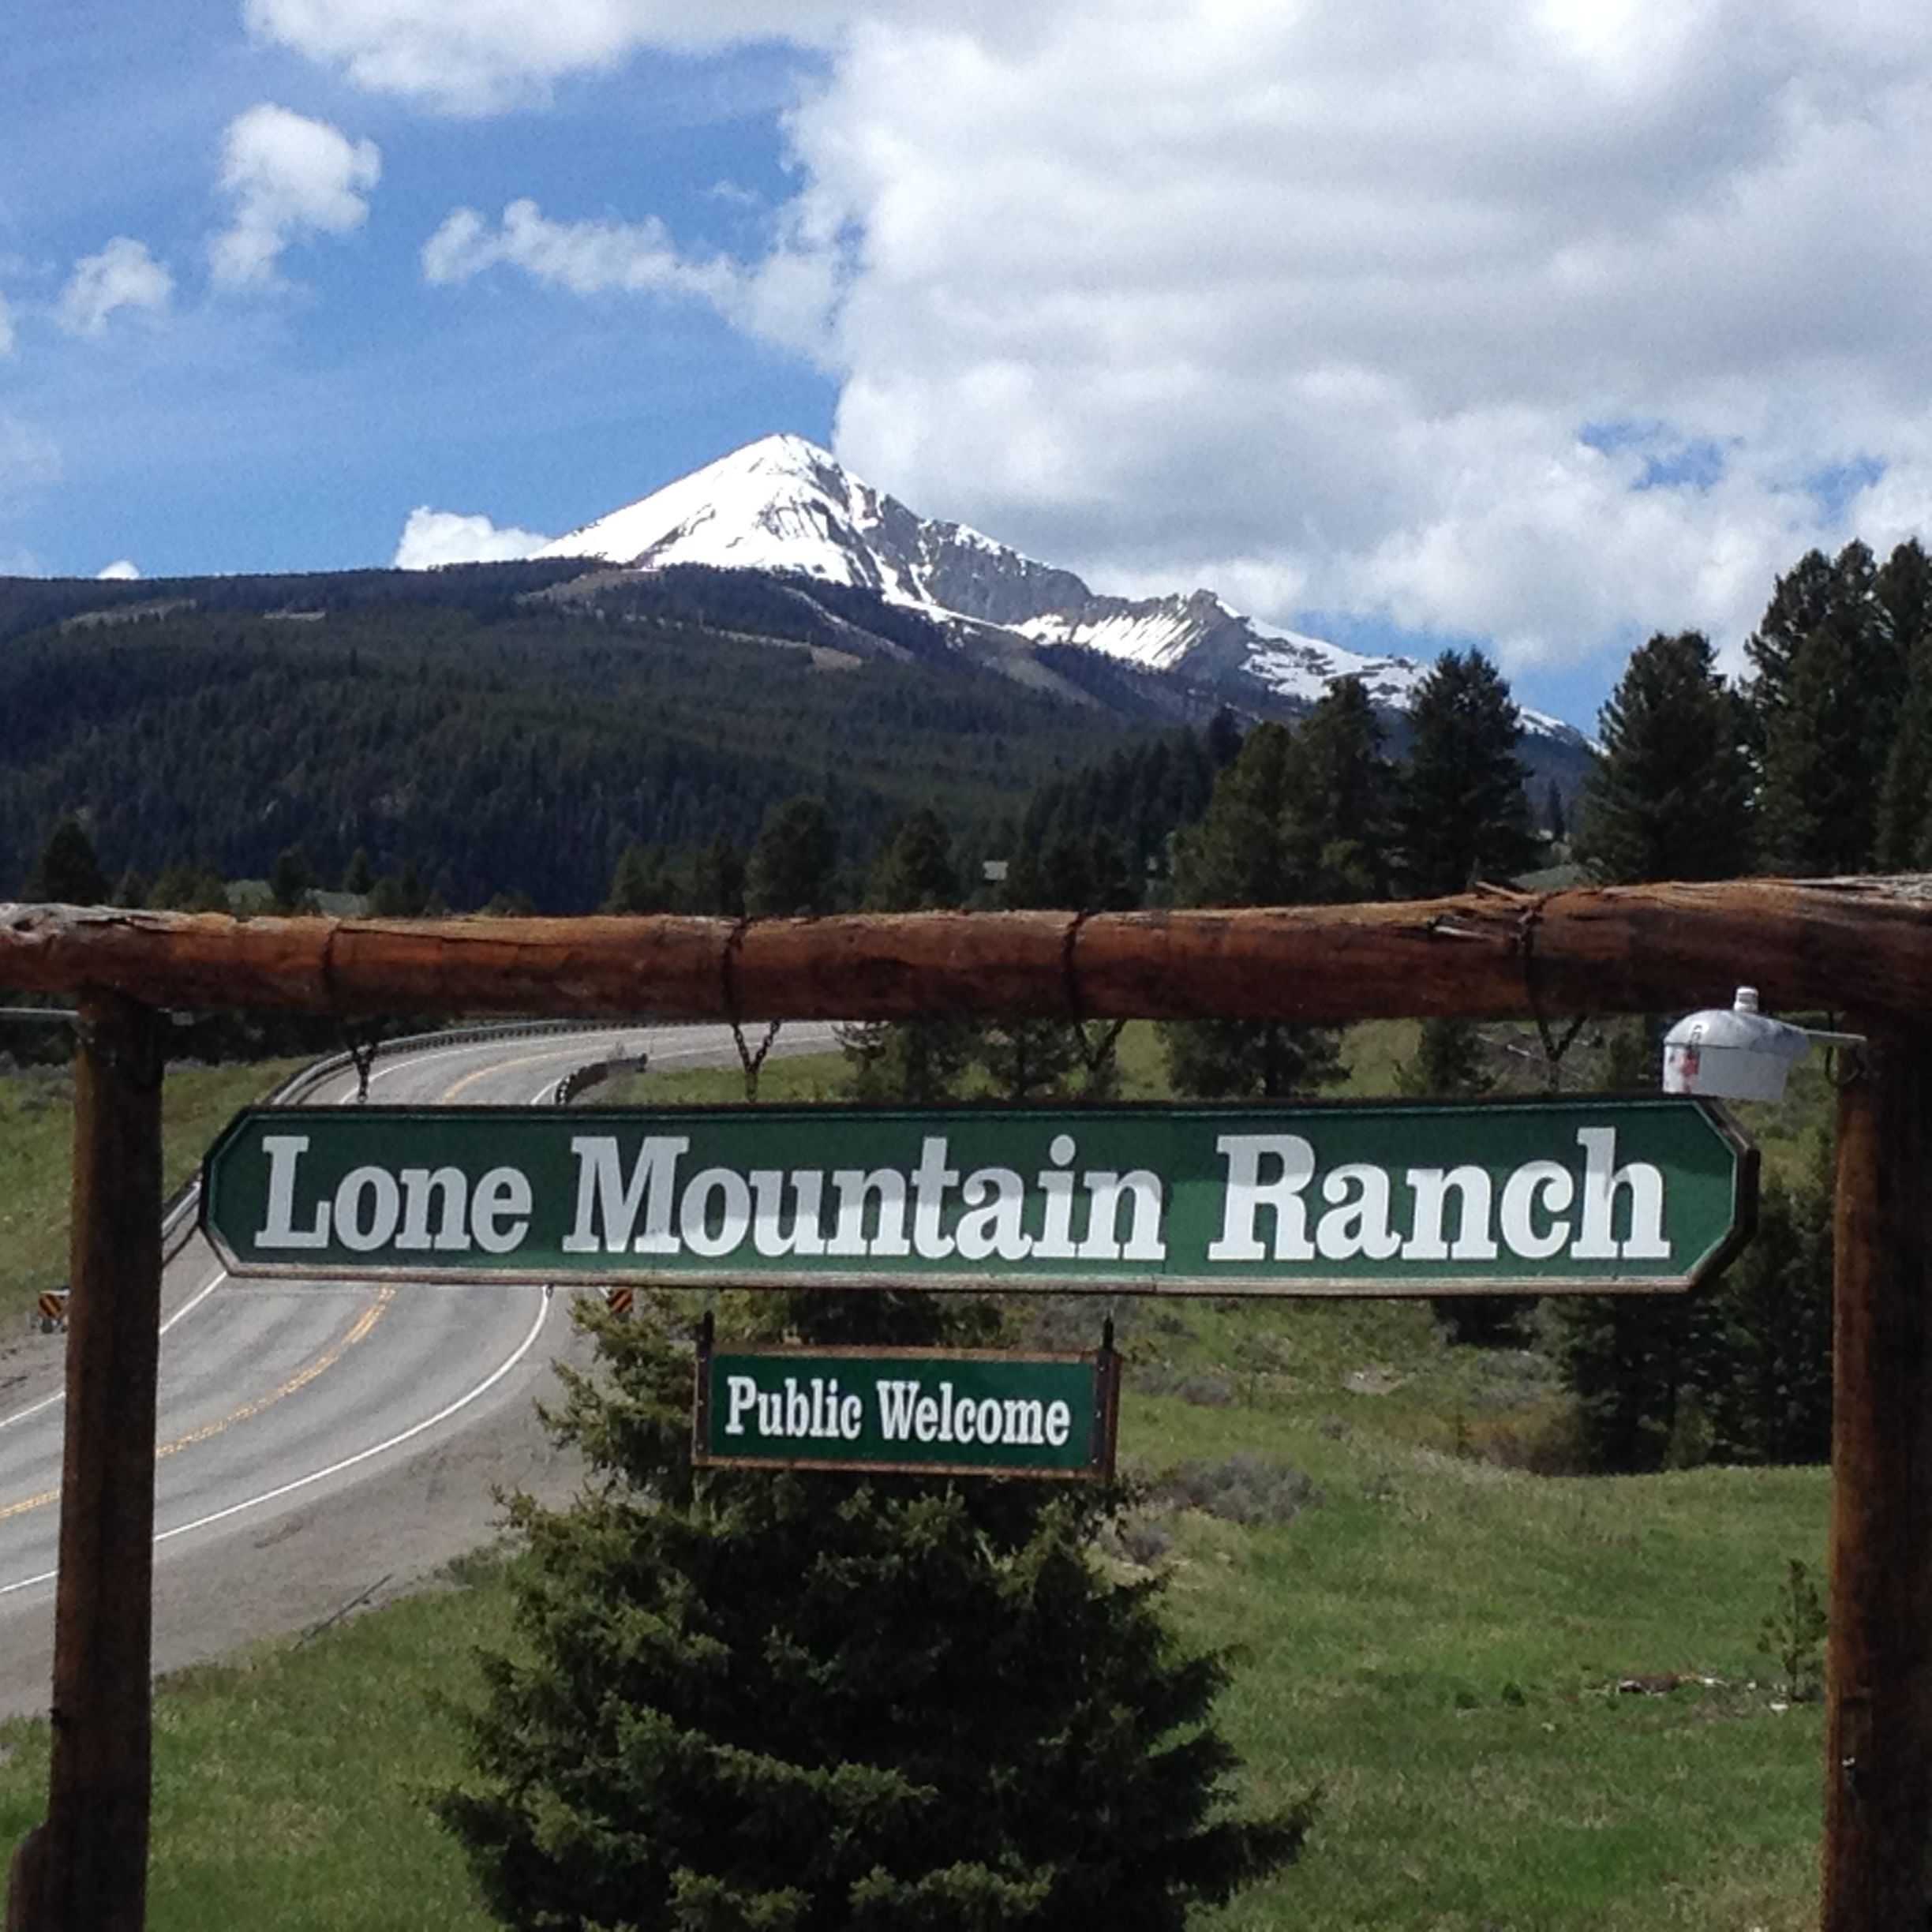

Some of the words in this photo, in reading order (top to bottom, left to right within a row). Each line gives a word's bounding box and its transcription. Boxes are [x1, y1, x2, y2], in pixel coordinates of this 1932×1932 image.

[254, 1135, 533, 1254] Lone
[562, 1134, 1167, 1261] Mountain
[1208, 1126, 1672, 1262] Ranch
[724, 1376, 863, 1440] Public
[876, 1380, 1071, 1446] Welcome
